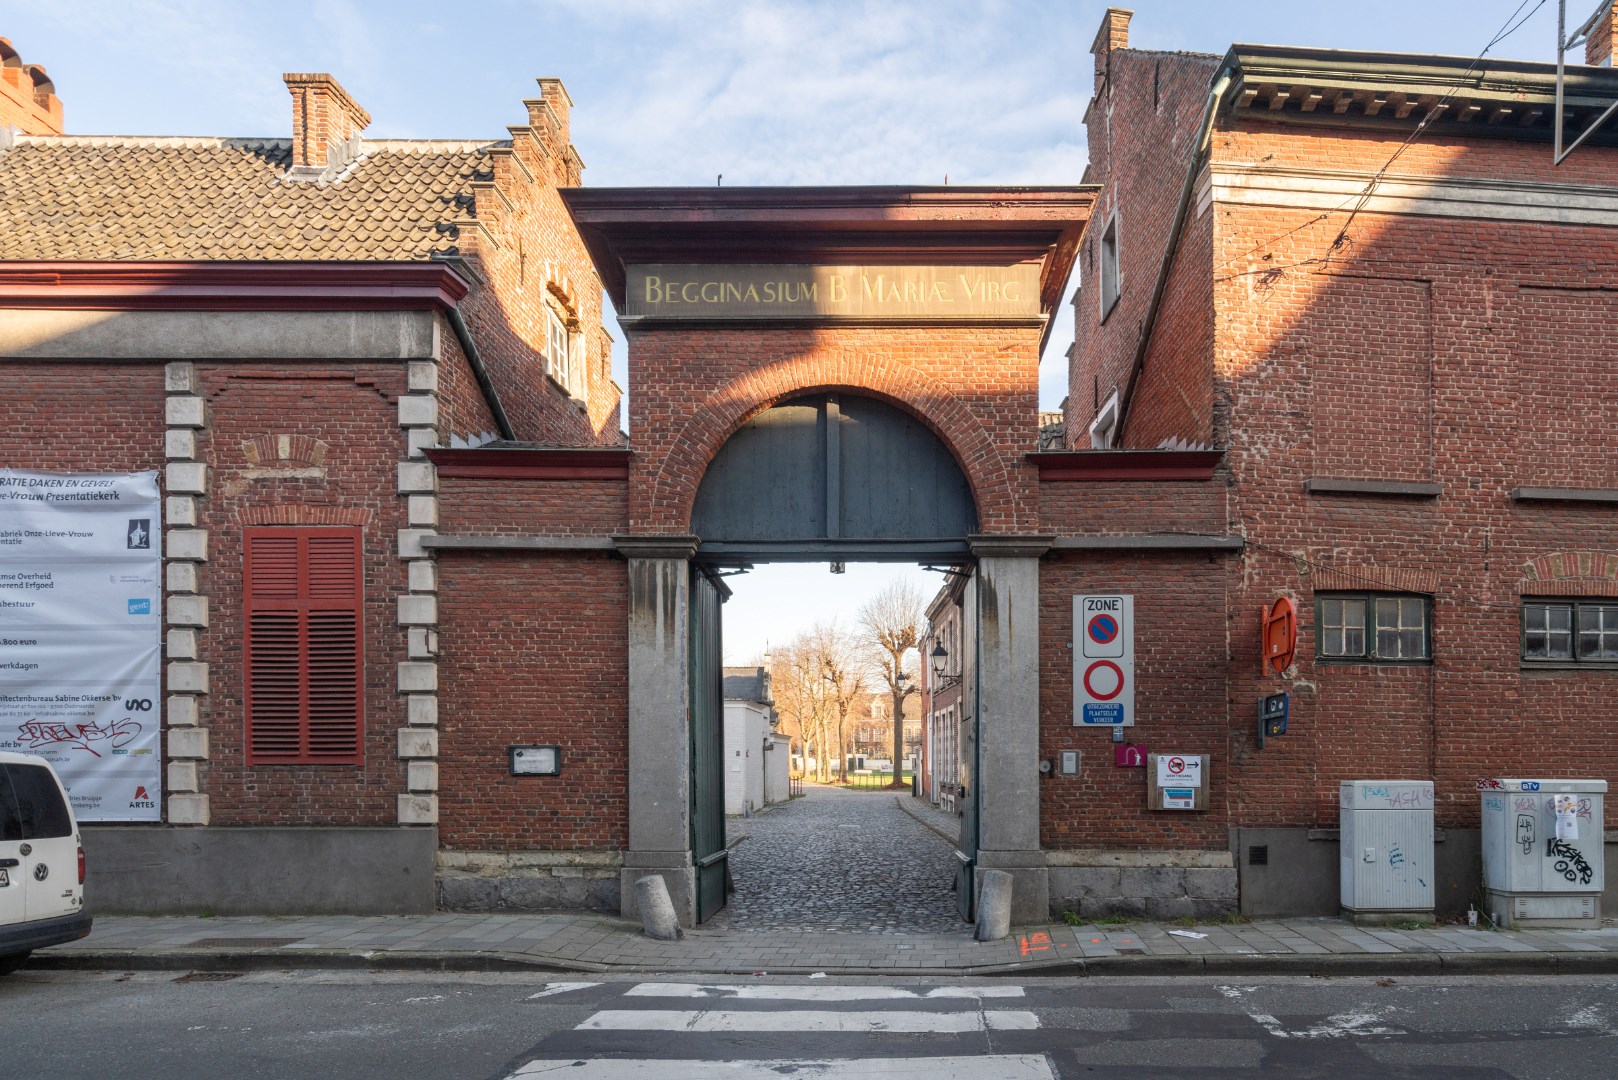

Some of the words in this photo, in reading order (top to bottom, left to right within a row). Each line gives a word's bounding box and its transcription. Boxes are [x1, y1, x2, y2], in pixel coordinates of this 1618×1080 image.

[645, 275, 818, 303] BEGGINASIUM
[29, 478, 64, 488] DAKEN
[65, 479, 80, 488] EN
[80, 480, 115, 488] GEVELS
[46, 490, 120, 501] Presentatiekerk
[0, 530, 23, 538] abriek
[24, 530, 94, 538] Onze-Lieve-Vrouw
[17, 572, 52, 580] Overheid
[25, 581, 54, 590] Erfgoed
[1087, 599, 1119, 611] ZONE
[54, 694, 80, 702] Sabine
[81, 694, 112, 702] Okkerse
[13, 740, 22, 748] bv
[129, 801, 155, 809] ARTES
